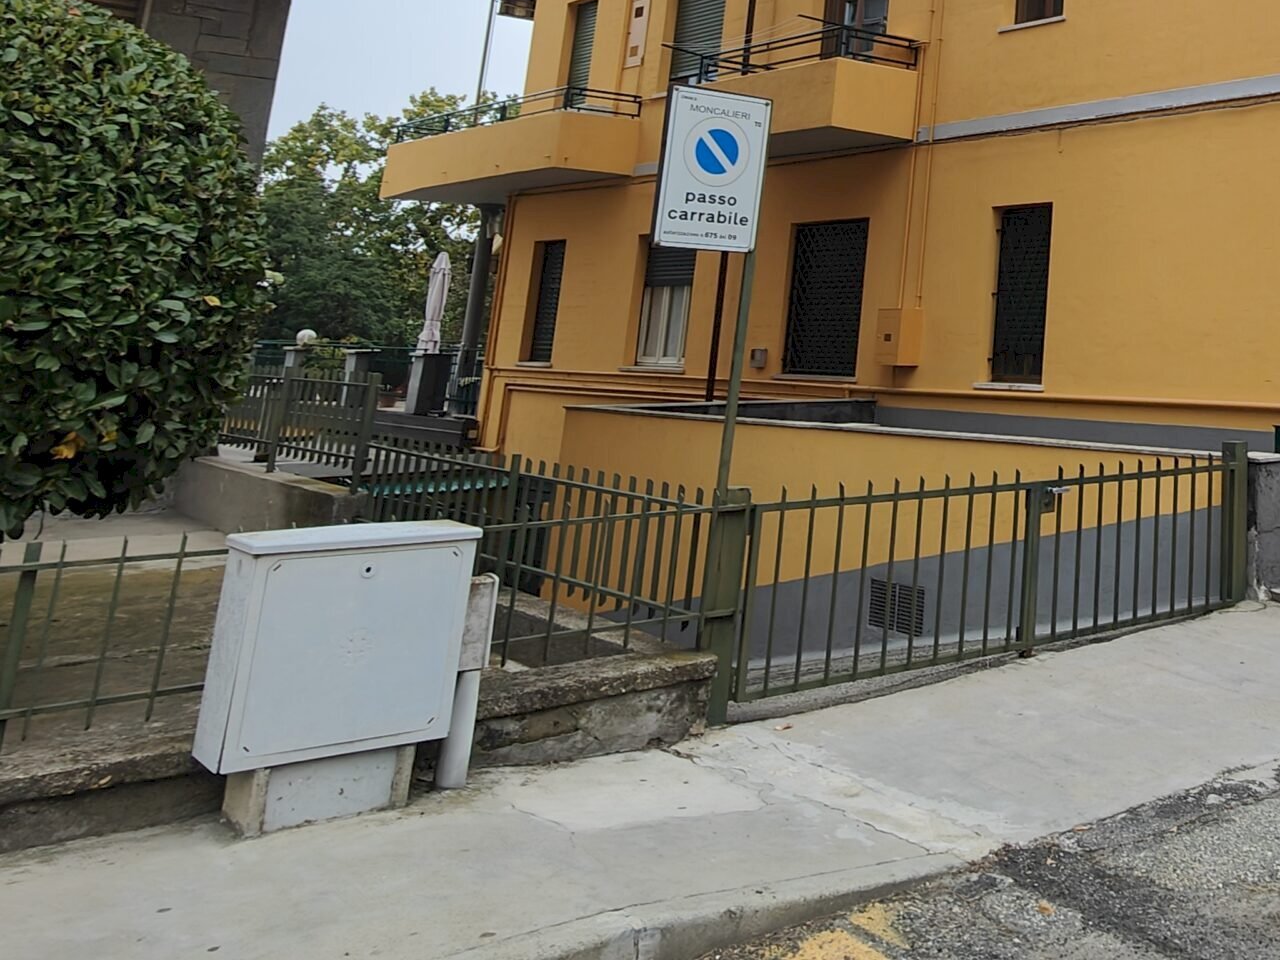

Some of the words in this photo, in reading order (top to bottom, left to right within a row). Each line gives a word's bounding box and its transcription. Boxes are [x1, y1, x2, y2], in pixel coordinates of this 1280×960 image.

[689, 104, 751, 120] MONCALIERI
[685, 191, 737, 207] passo
[667, 209, 749, 227] carrabile
[704, 231, 718, 239] 675
